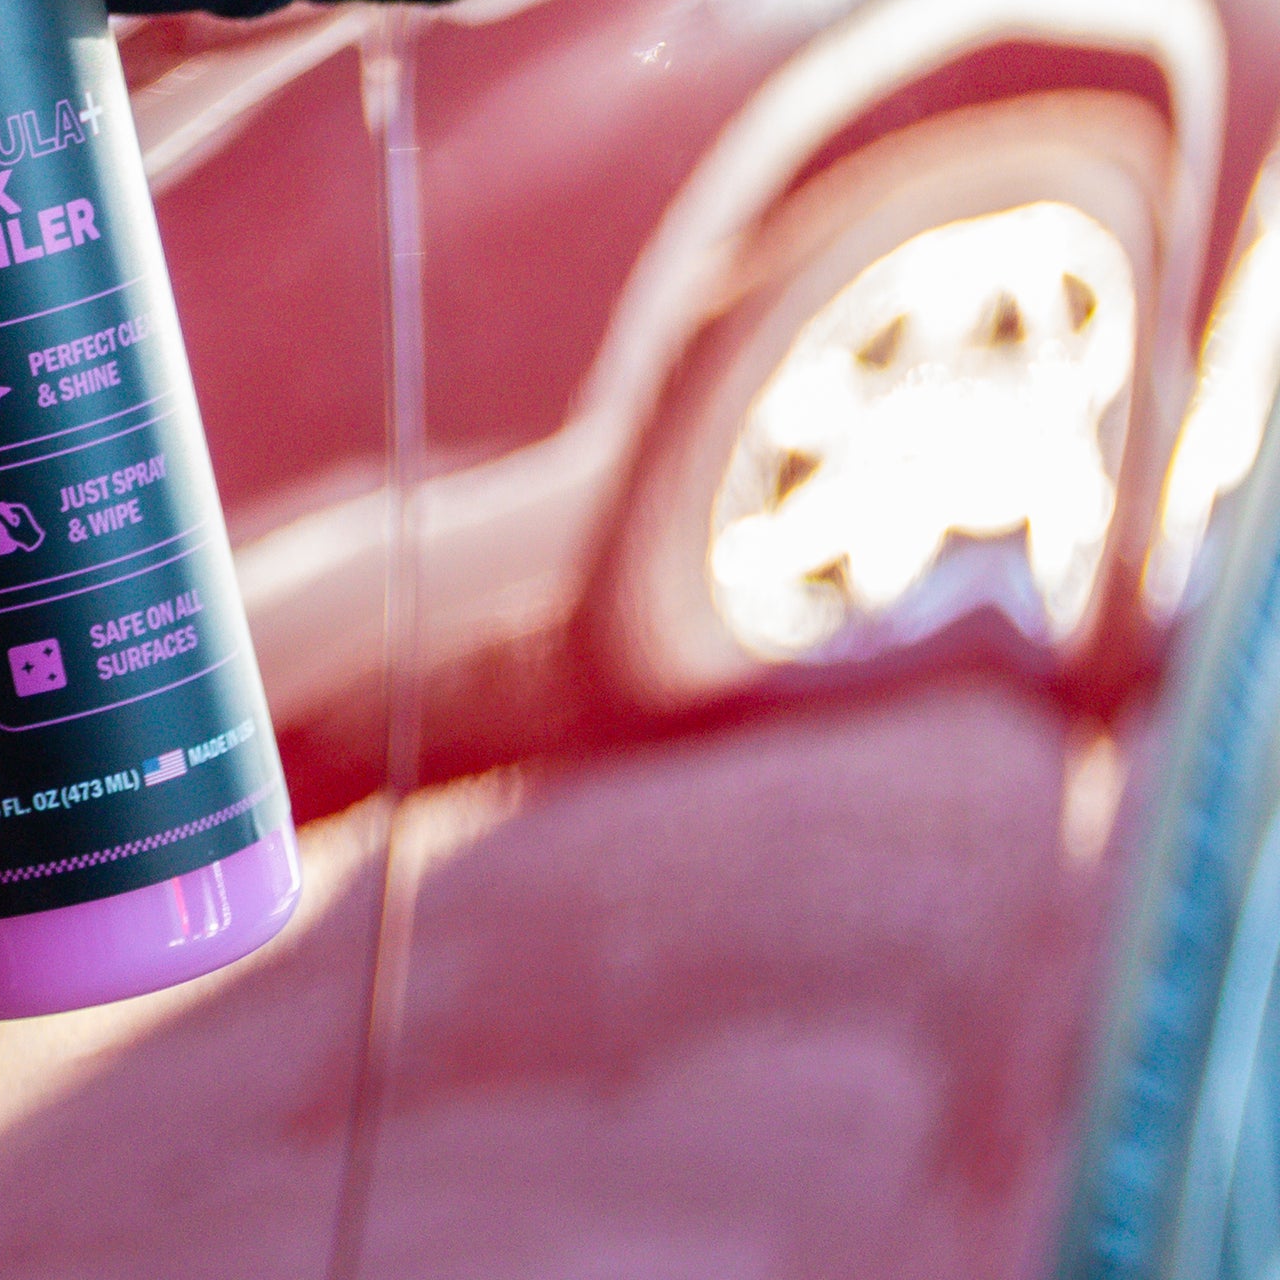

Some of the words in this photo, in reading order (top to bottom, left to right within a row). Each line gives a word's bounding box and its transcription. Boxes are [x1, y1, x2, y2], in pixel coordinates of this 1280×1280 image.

[28, 327, 116, 376] PERFECT
[37, 383, 58, 408] &
[58, 360, 121, 401] SHINE
[60, 475, 109, 513] JUST
[111, 453, 166, 495] SPRAY
[68, 518, 88, 543] &
[87, 498, 143, 536] WIPE
[90, 611, 147, 649] SAFE
[146, 600, 175, 630] ON
[176, 589, 204, 620] ALL
[96, 625, 198, 681] SURFACES
[2, 796, 32, 818] FL.
[32, 789, 61, 811] OZ
[60, 778, 104, 809] (473
[104, 769, 140, 794] ML)
[188, 734, 228, 767] MADE
